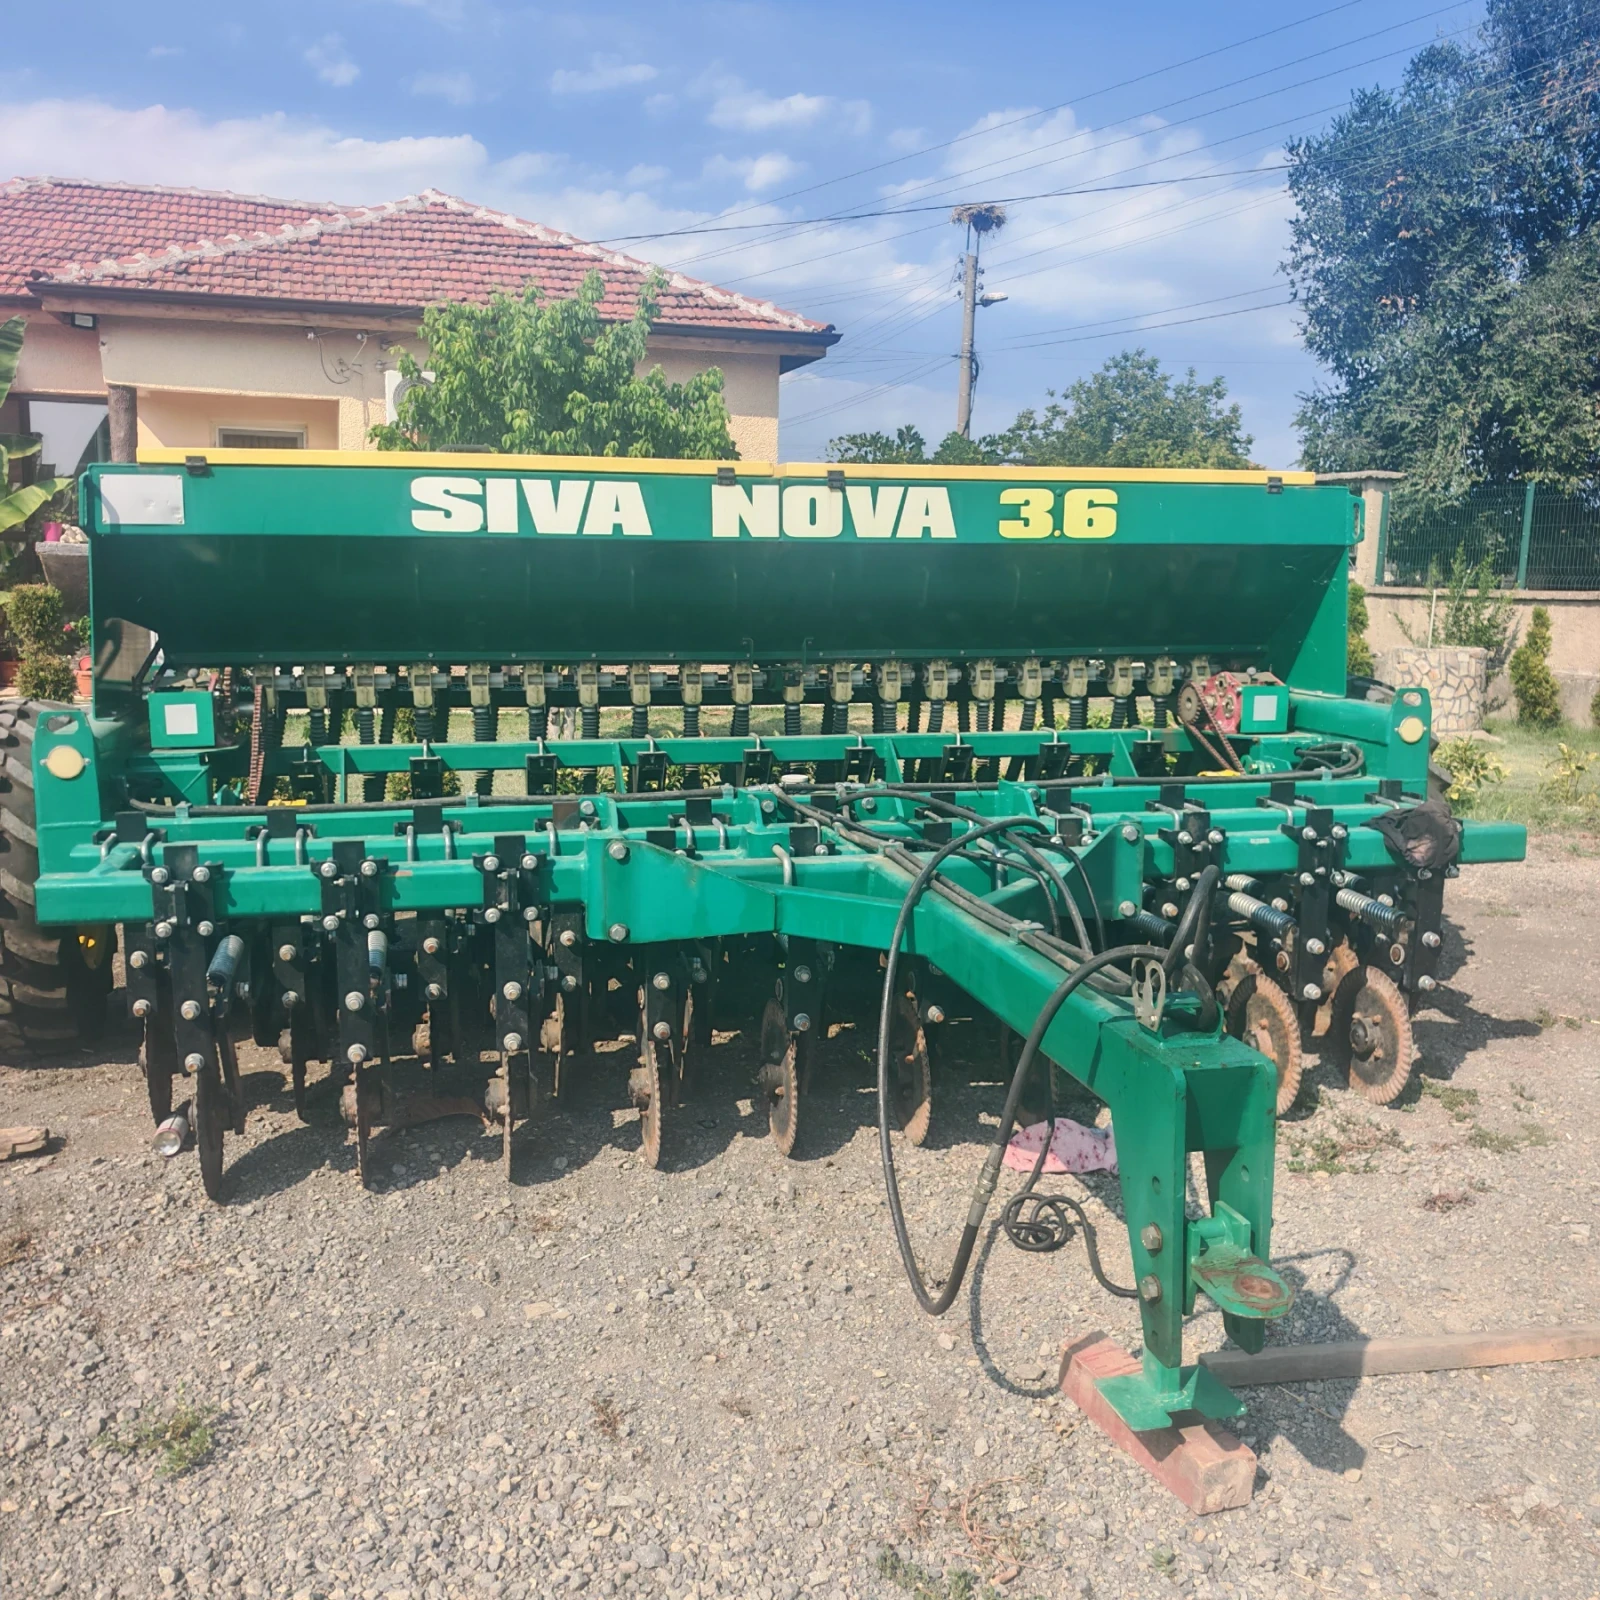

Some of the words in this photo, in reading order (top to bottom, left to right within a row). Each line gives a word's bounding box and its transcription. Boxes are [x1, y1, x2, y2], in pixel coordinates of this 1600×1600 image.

[410, 476, 653, 536] SIVA
[711, 484, 957, 539] NOVA
[998, 487, 1119, 540] 3.6
